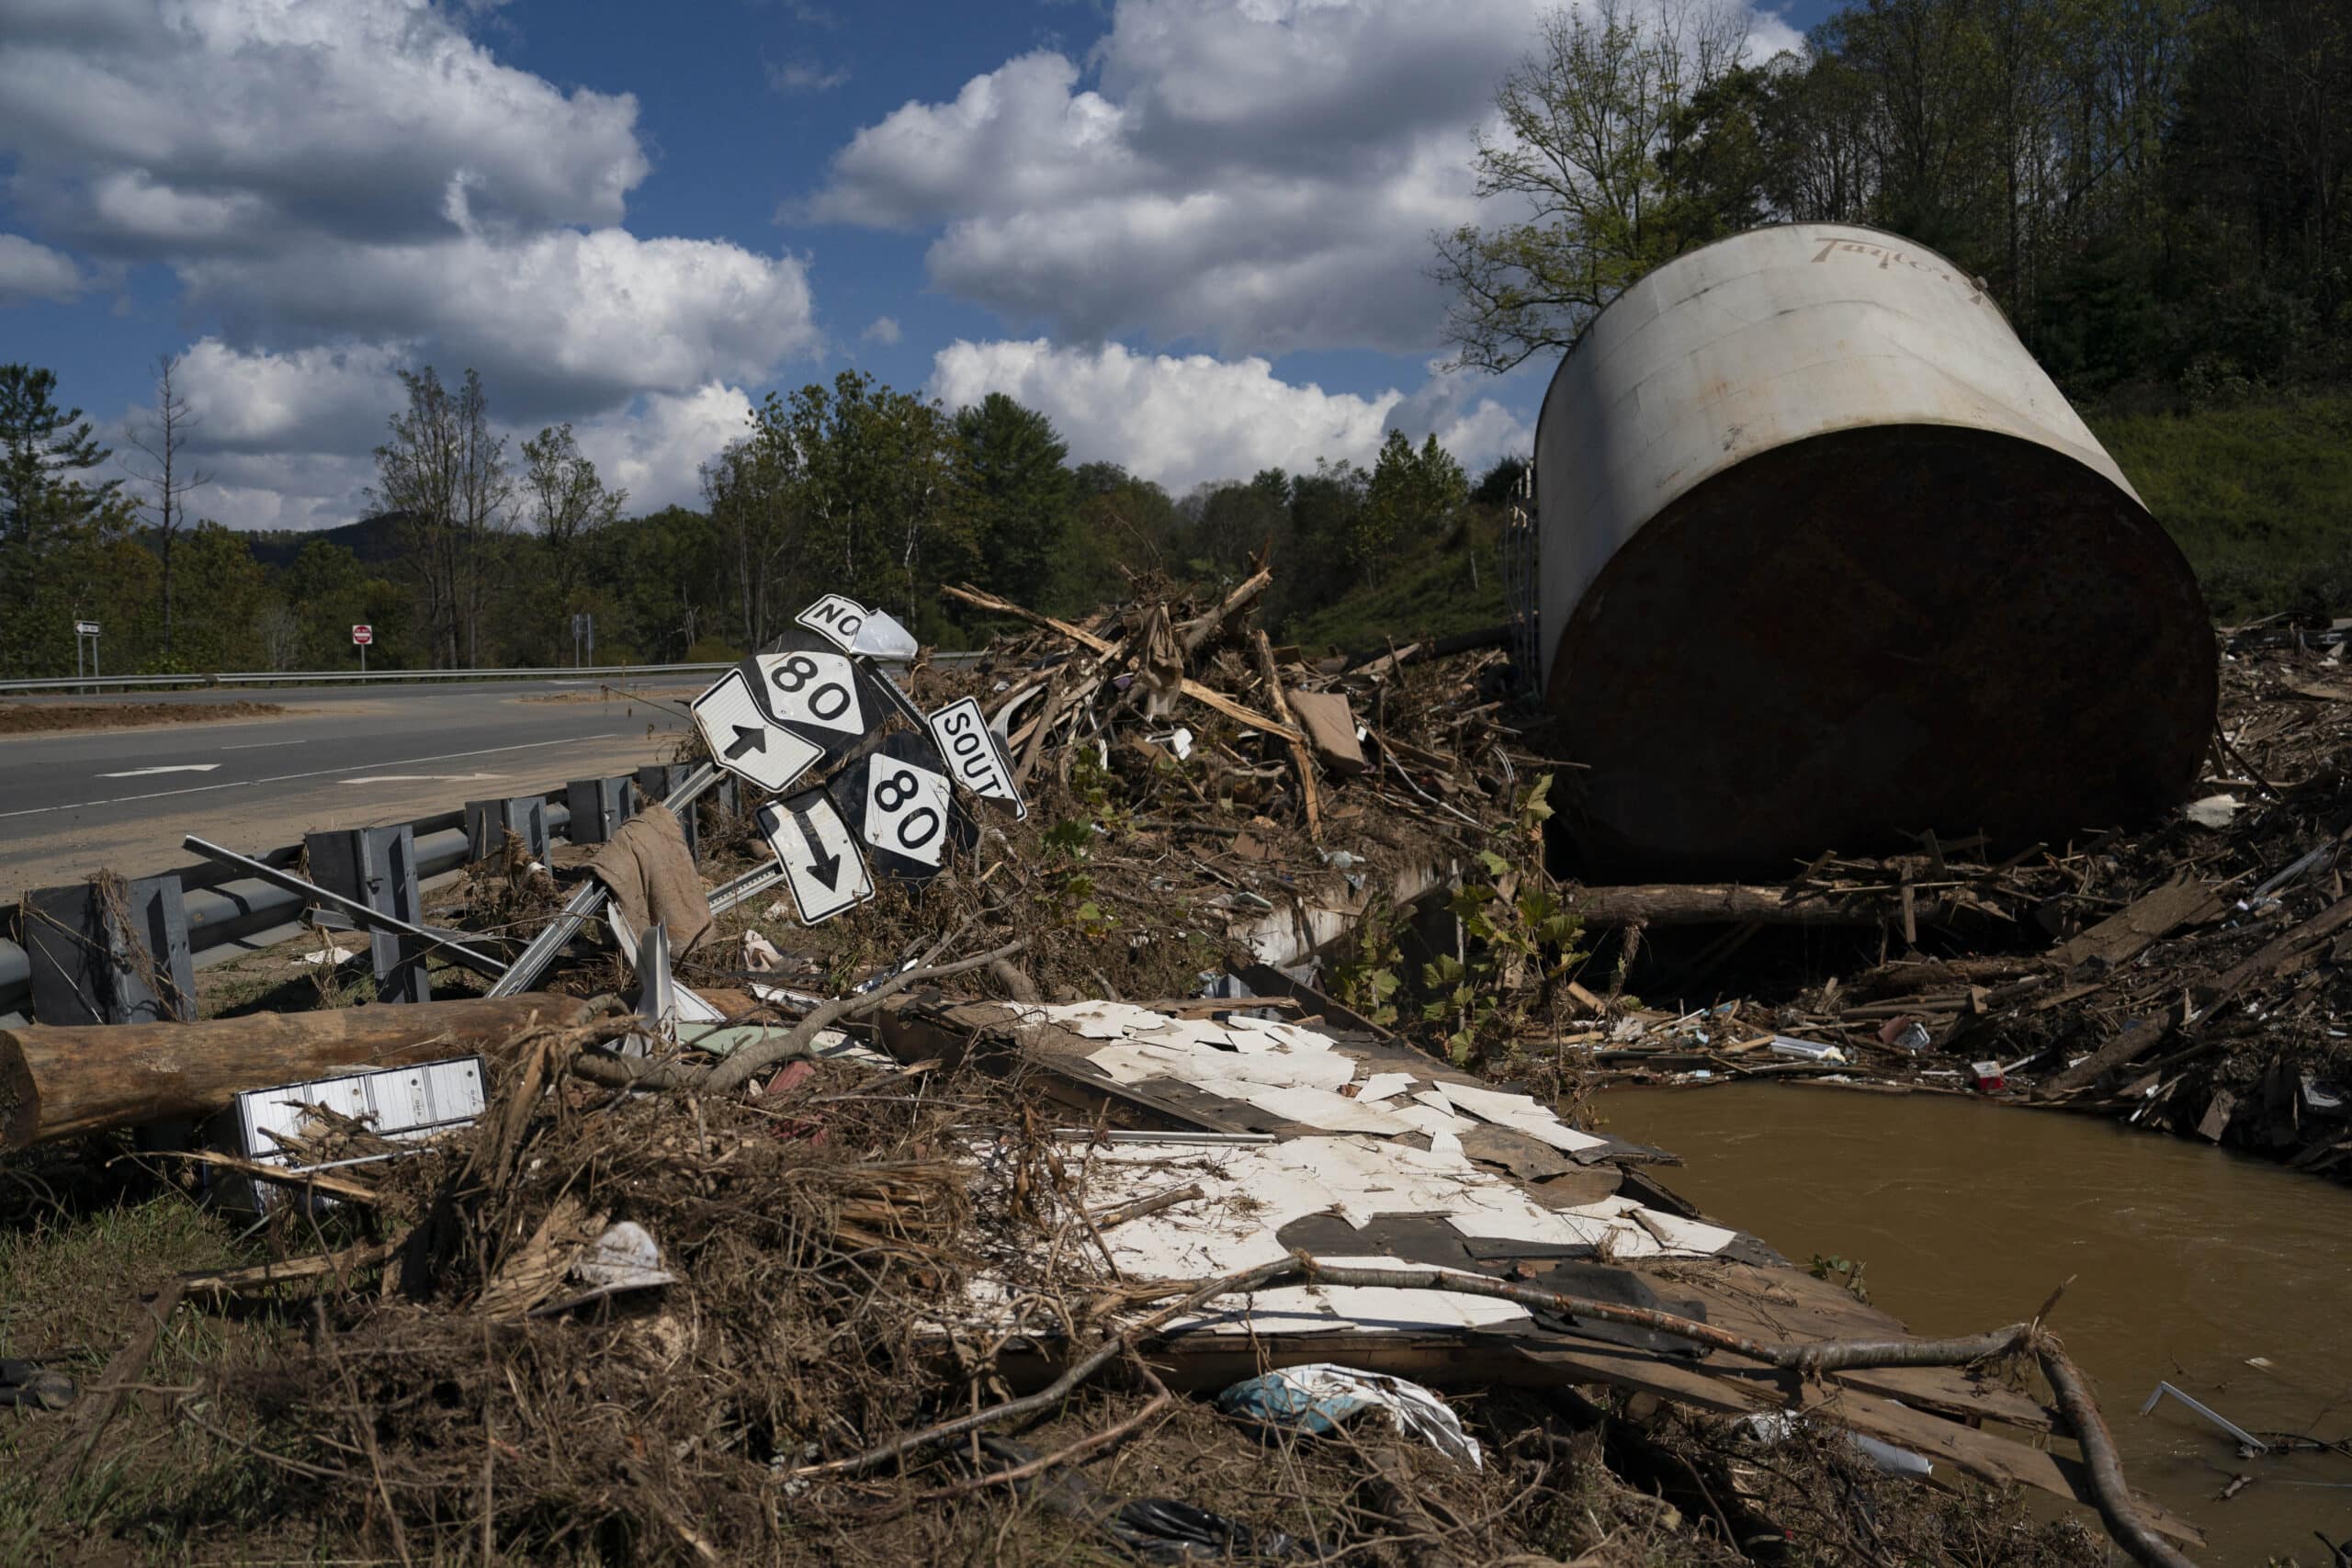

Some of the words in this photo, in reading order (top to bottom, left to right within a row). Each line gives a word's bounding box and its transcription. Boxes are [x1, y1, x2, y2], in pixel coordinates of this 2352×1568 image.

[771, 656, 851, 721] 80
[944, 712, 1006, 798] SOUT
[874, 769, 940, 850] 80
